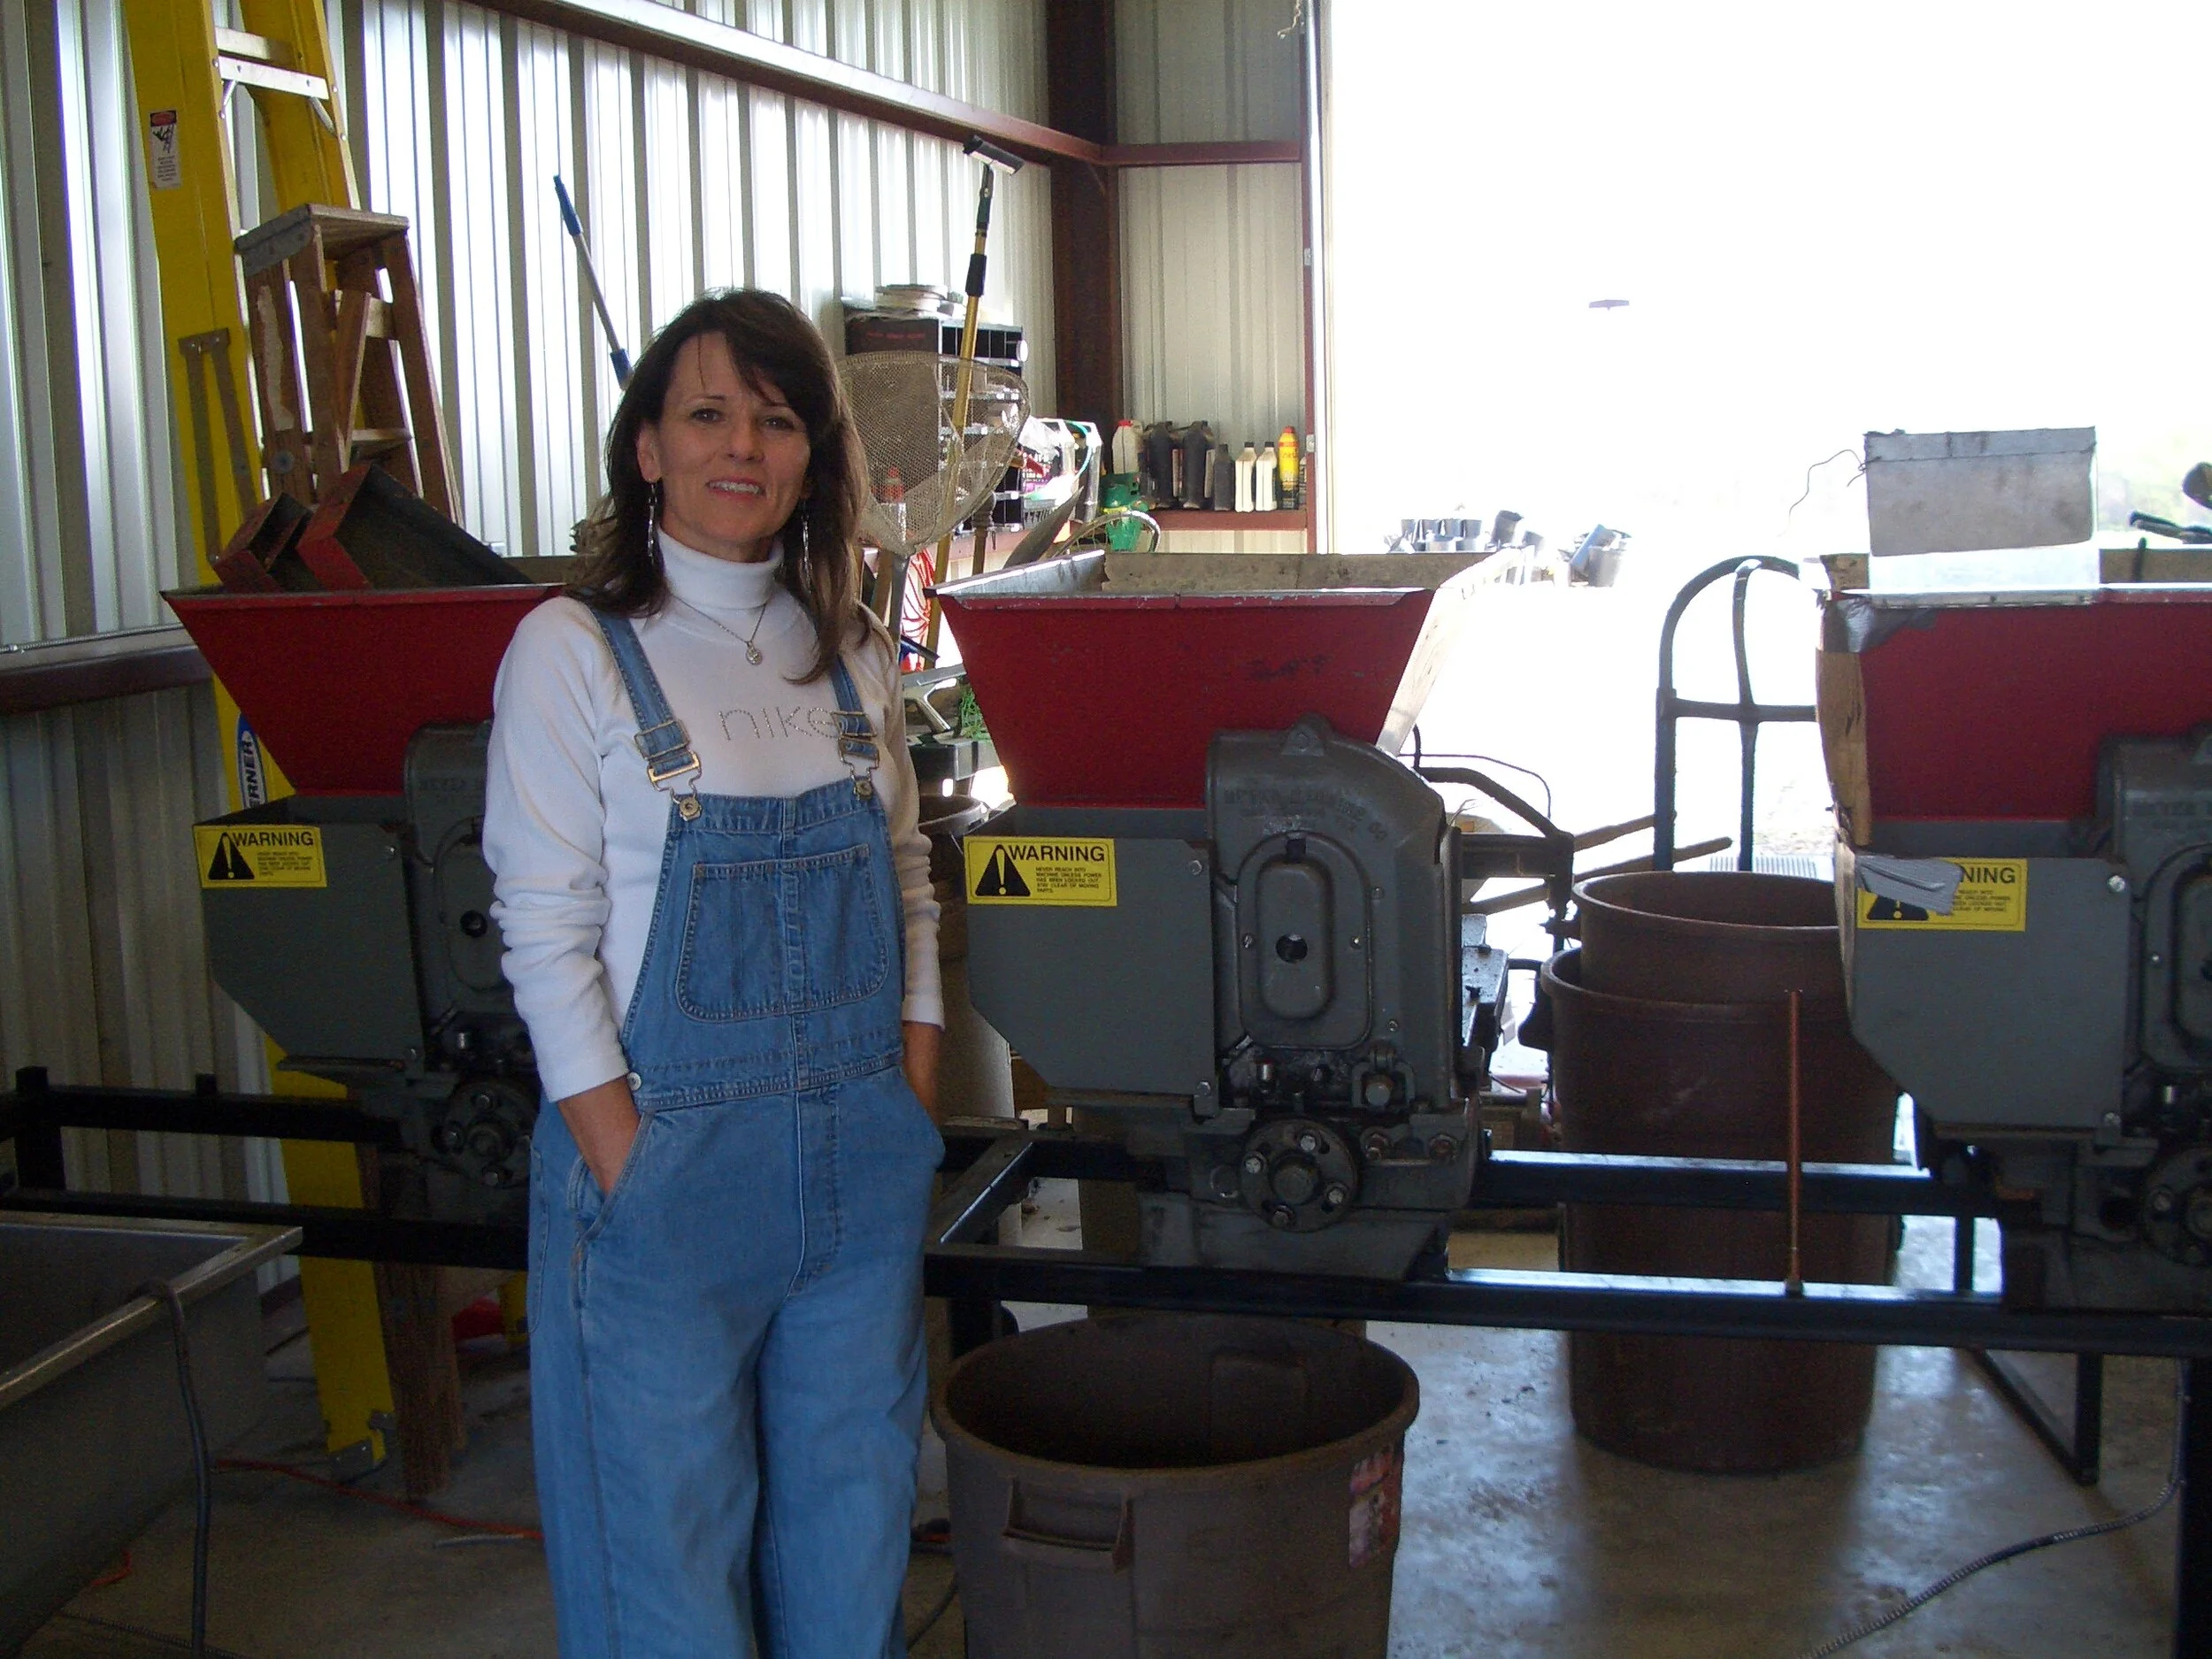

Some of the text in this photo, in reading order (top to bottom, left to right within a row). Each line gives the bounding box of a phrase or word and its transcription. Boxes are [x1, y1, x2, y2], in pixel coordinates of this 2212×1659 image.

[242, 740, 261, 808] ERNER
[232, 832, 313, 847] WARNING
[1009, 845, 1105, 862] WARNING
[1959, 866, 2016, 884] NING
